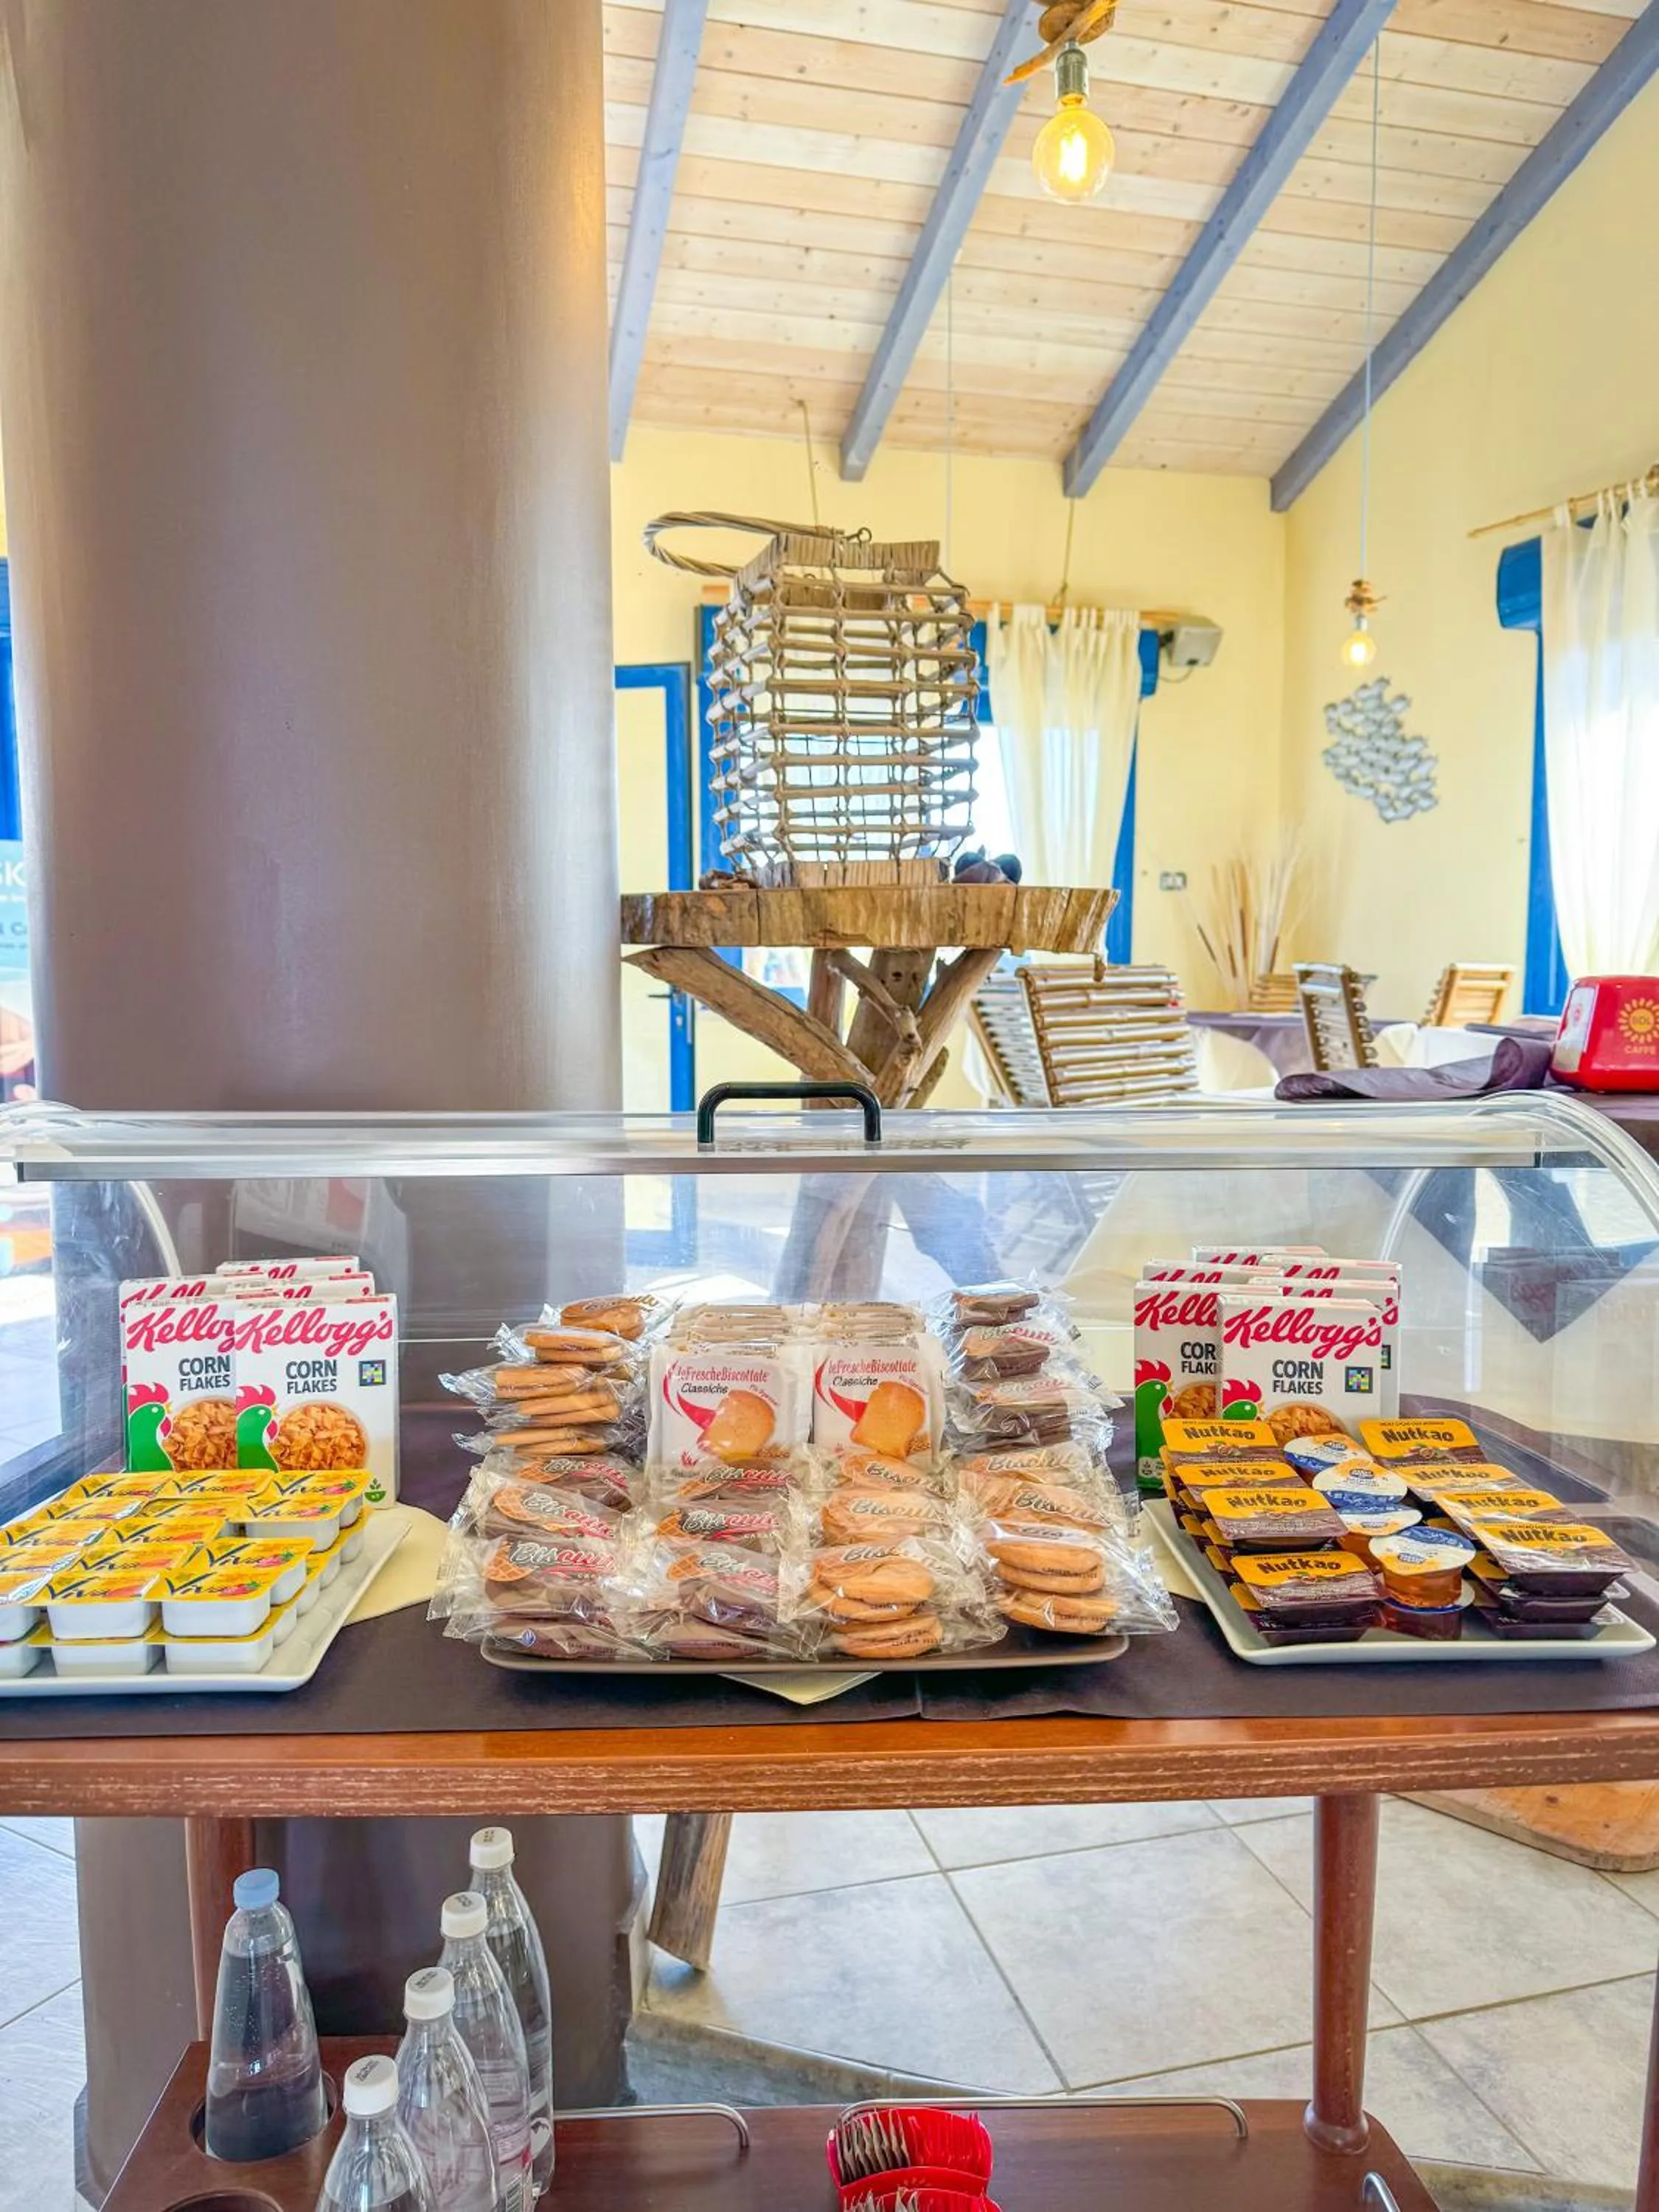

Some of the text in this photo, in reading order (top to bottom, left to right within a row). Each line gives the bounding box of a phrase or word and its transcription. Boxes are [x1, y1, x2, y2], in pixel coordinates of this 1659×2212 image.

[126, 1304, 234, 1352] Kellog
[235, 1308, 393, 1357] Kellogg's
[1222, 1306, 1381, 1360] Kellogg's
[1180, 1342, 1217, 1360] COR
[178, 1355, 231, 1377] CORN
[285, 1360, 337, 1380] CORN
[1181, 1361, 1217, 1374] FLAK
[1272, 1360, 1324, 1380] CORN
[179, 1374, 231, 1391] FLAKES
[287, 1379, 337, 1395] FLAKES
[1273, 1380, 1324, 1394] FLAKES
[1183, 1425, 1255, 1440] Nutkao
[1381, 1427, 1455, 1444] Nutkao
[1201, 1466, 1275, 1477] Nutkao
[1413, 1469, 1489, 1481] Nutkao
[1226, 1493, 1307, 1508] Nutkao
[1458, 1495, 1540, 1509] Nutkao
[1500, 1529, 1587, 1543] Nutkao
[1256, 1557, 1341, 1573] Nutkao
